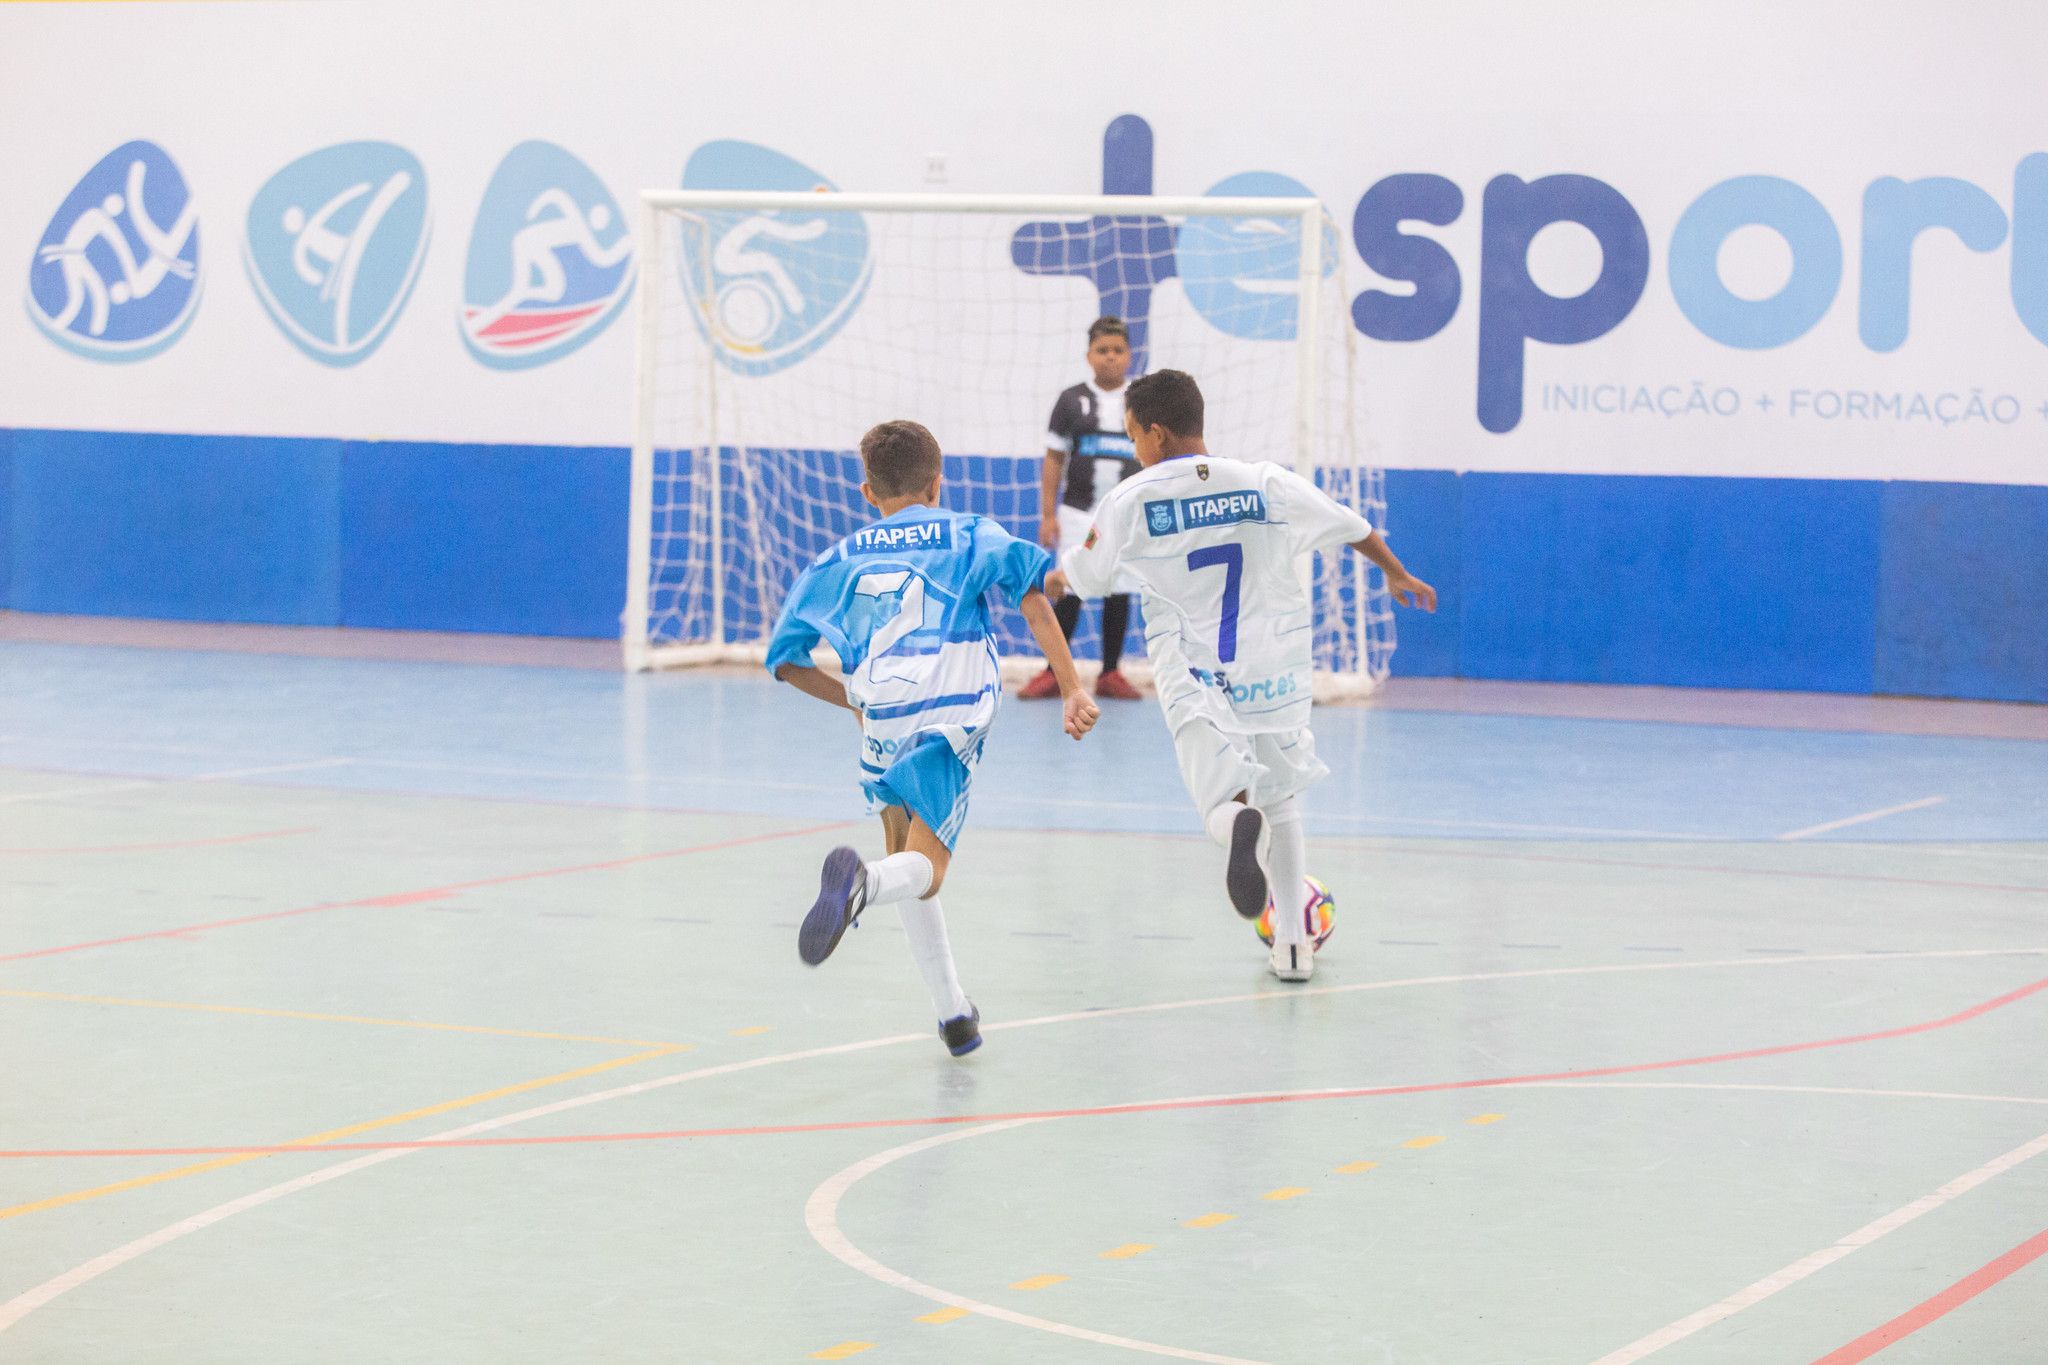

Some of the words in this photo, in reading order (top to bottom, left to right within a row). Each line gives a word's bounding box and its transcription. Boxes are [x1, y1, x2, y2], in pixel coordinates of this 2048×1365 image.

[1543, 379, 1741, 418] INICIAÇÃO
[1789, 387, 2021, 427] FORMAÇÃO
[1189, 494, 1258, 520] ITAPEVI
[855, 523, 941, 546] ITAPEVI
[1187, 542, 1243, 664] 7
[854, 569, 940, 686] 2
